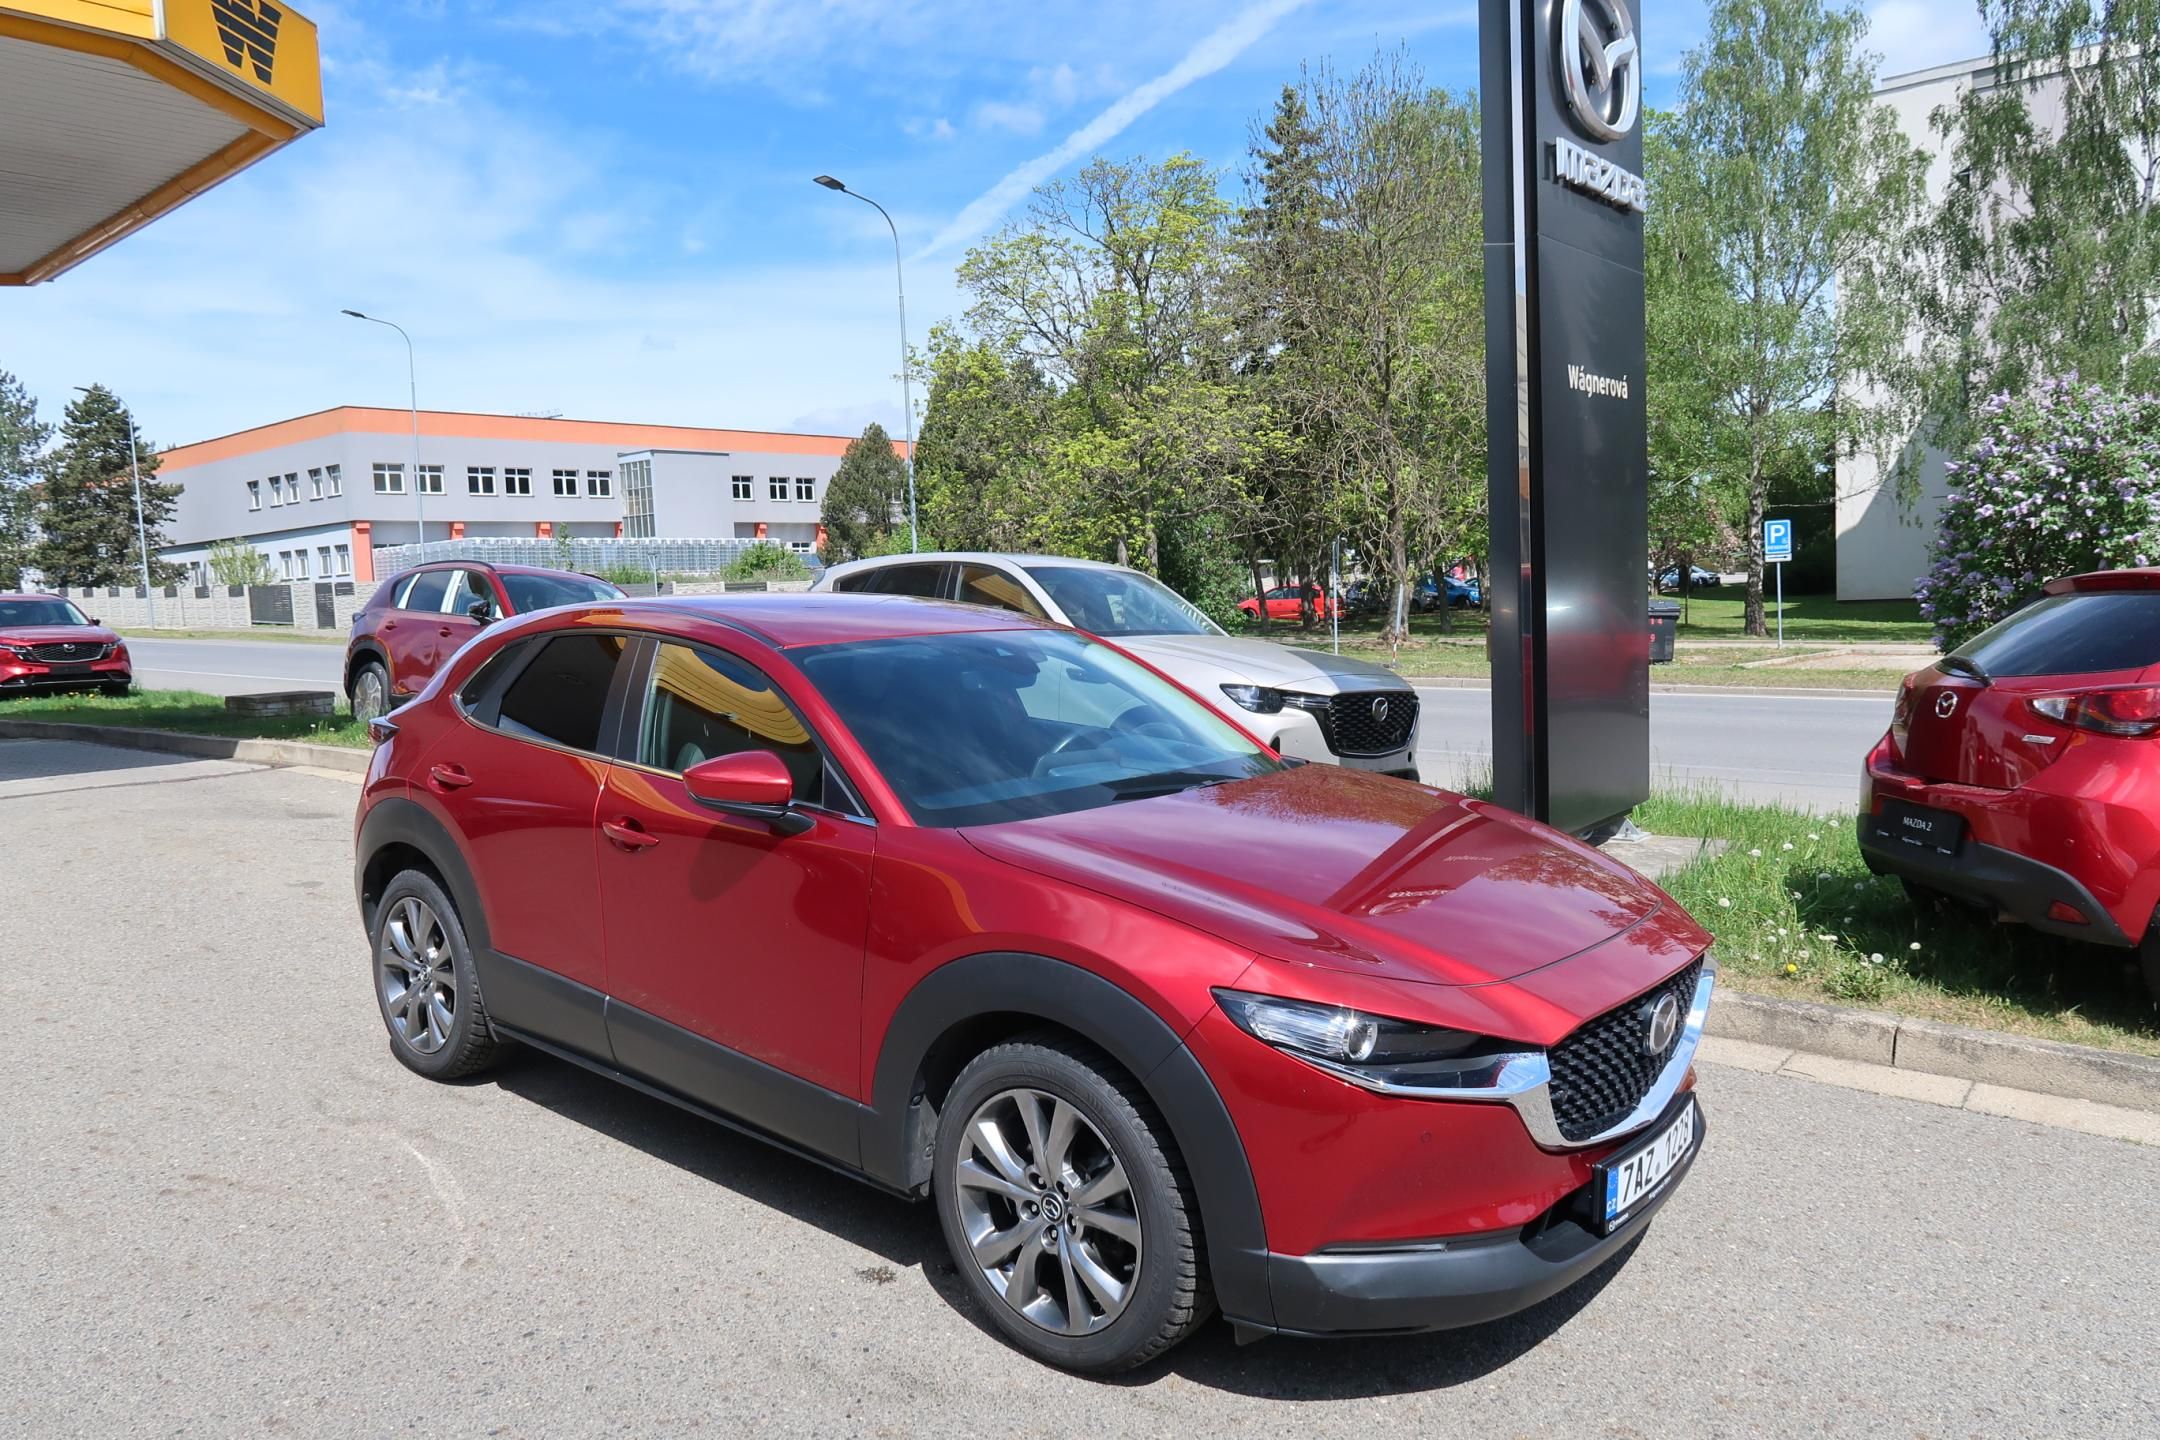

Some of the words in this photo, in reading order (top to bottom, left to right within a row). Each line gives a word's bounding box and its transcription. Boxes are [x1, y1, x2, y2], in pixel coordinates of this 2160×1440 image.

[1567, 363, 1629, 399] Wágnerová
[1770, 524, 1785, 545] P
[1903, 816, 1926, 830] MAZDA
[1926, 822, 1932, 832] 2
[1623, 1147, 1656, 1203] 7AZ
[1607, 1197, 1617, 1213] CZ
